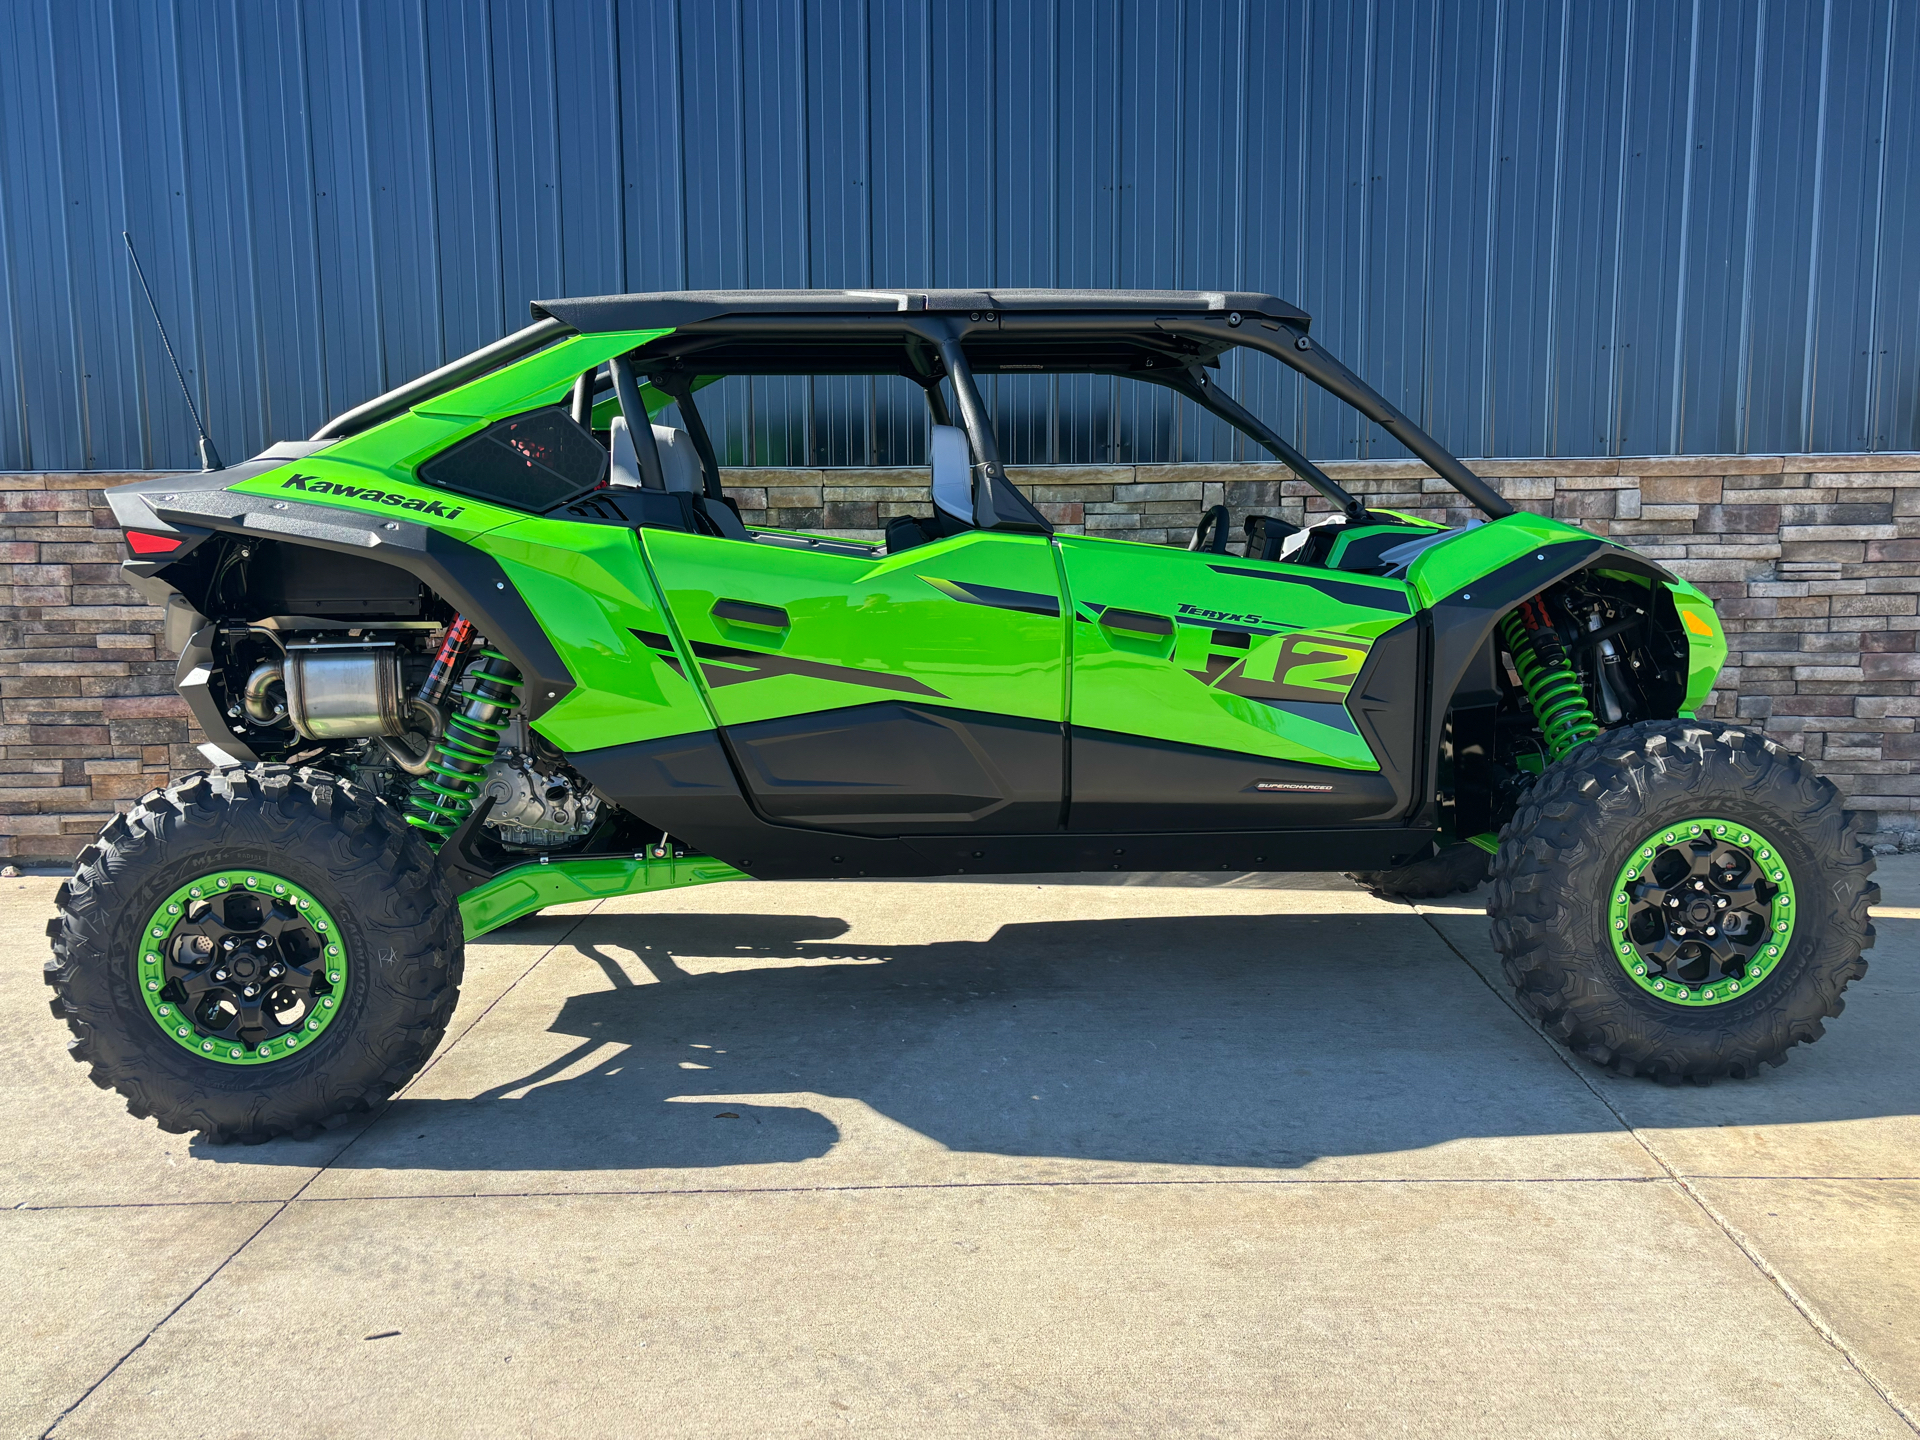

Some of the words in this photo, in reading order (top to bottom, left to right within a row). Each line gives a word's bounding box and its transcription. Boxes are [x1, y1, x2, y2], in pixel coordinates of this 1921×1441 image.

[281, 473, 466, 520] Kawasaki
[1172, 622, 1368, 693] H2
[1257, 783, 1334, 791] SUPERCHARGED
[1612, 799, 1747, 863] MAXXIS
[111, 869, 175, 1011] MAXXIS
[339, 908, 366, 1018] CARNIVORE
[1733, 943, 1814, 1020] CARNIVORE
